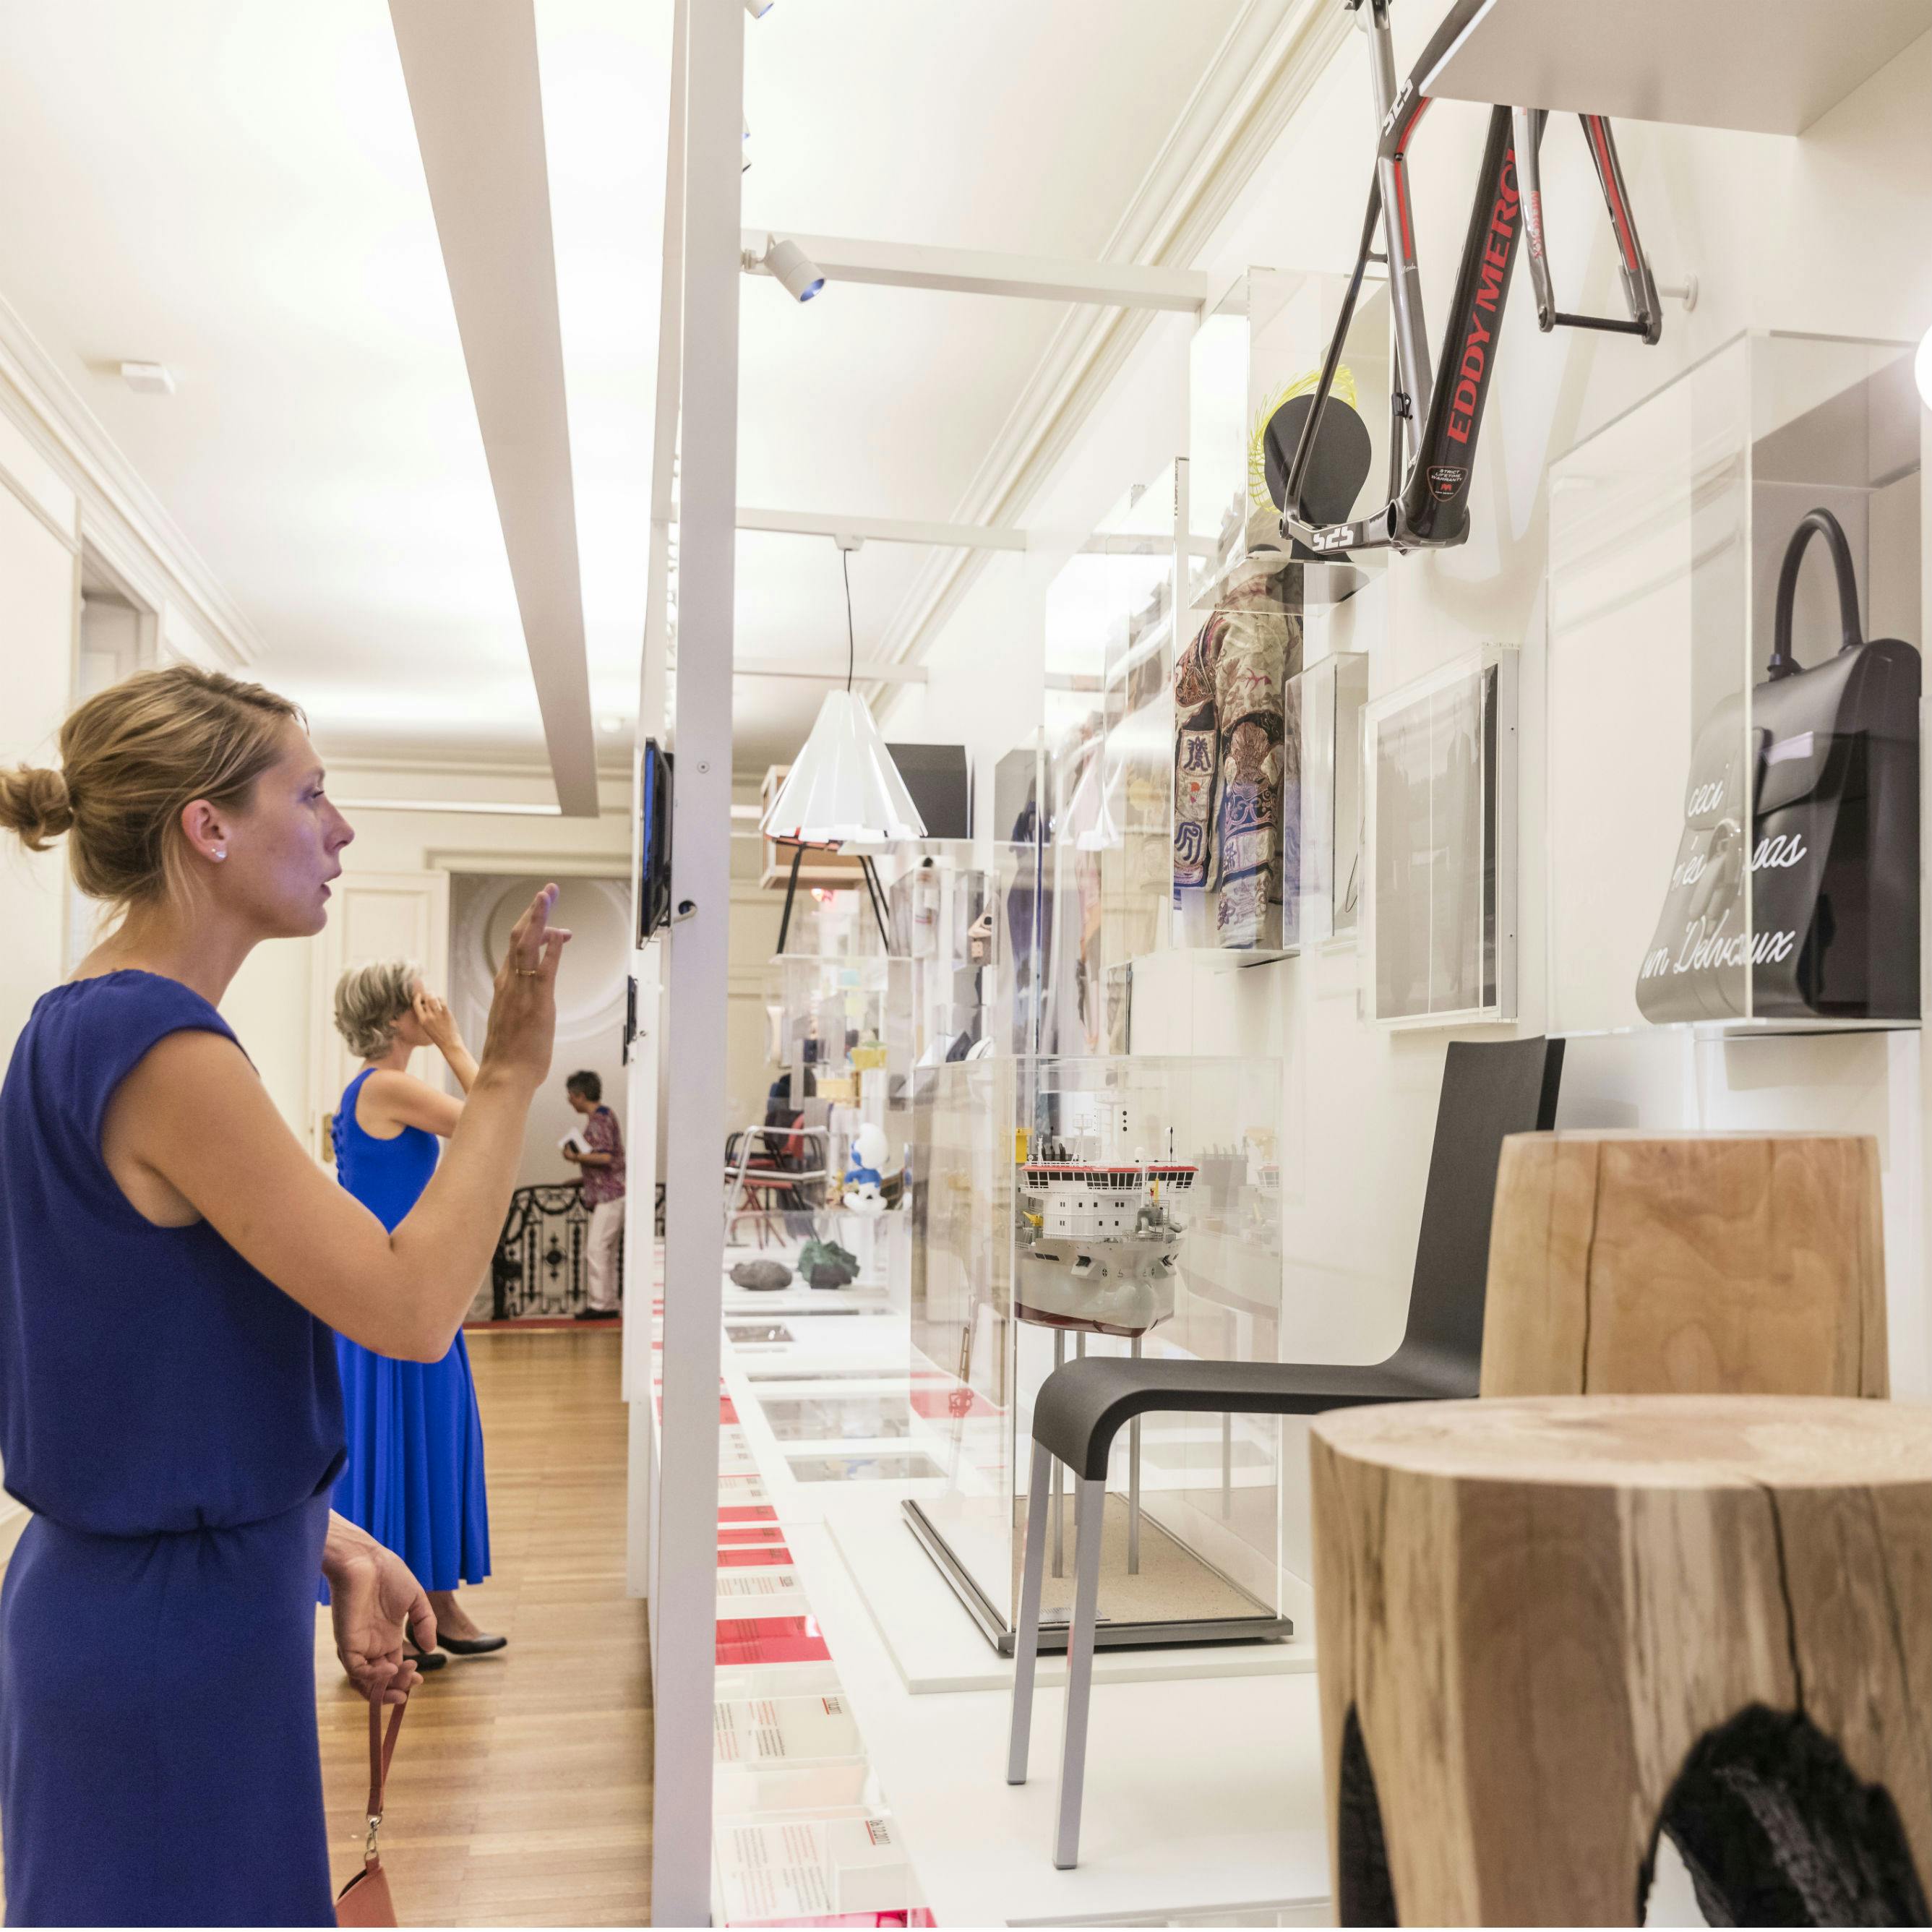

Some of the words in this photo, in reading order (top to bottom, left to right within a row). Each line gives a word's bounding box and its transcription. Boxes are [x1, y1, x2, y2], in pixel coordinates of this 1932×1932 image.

[1447, 312, 1491, 445] EDDY
[1474, 149, 1521, 313] MERC
[1688, 763, 1729, 817] ceci
[1641, 947, 1670, 979] un
[1673, 909, 1796, 974] Delvaux
